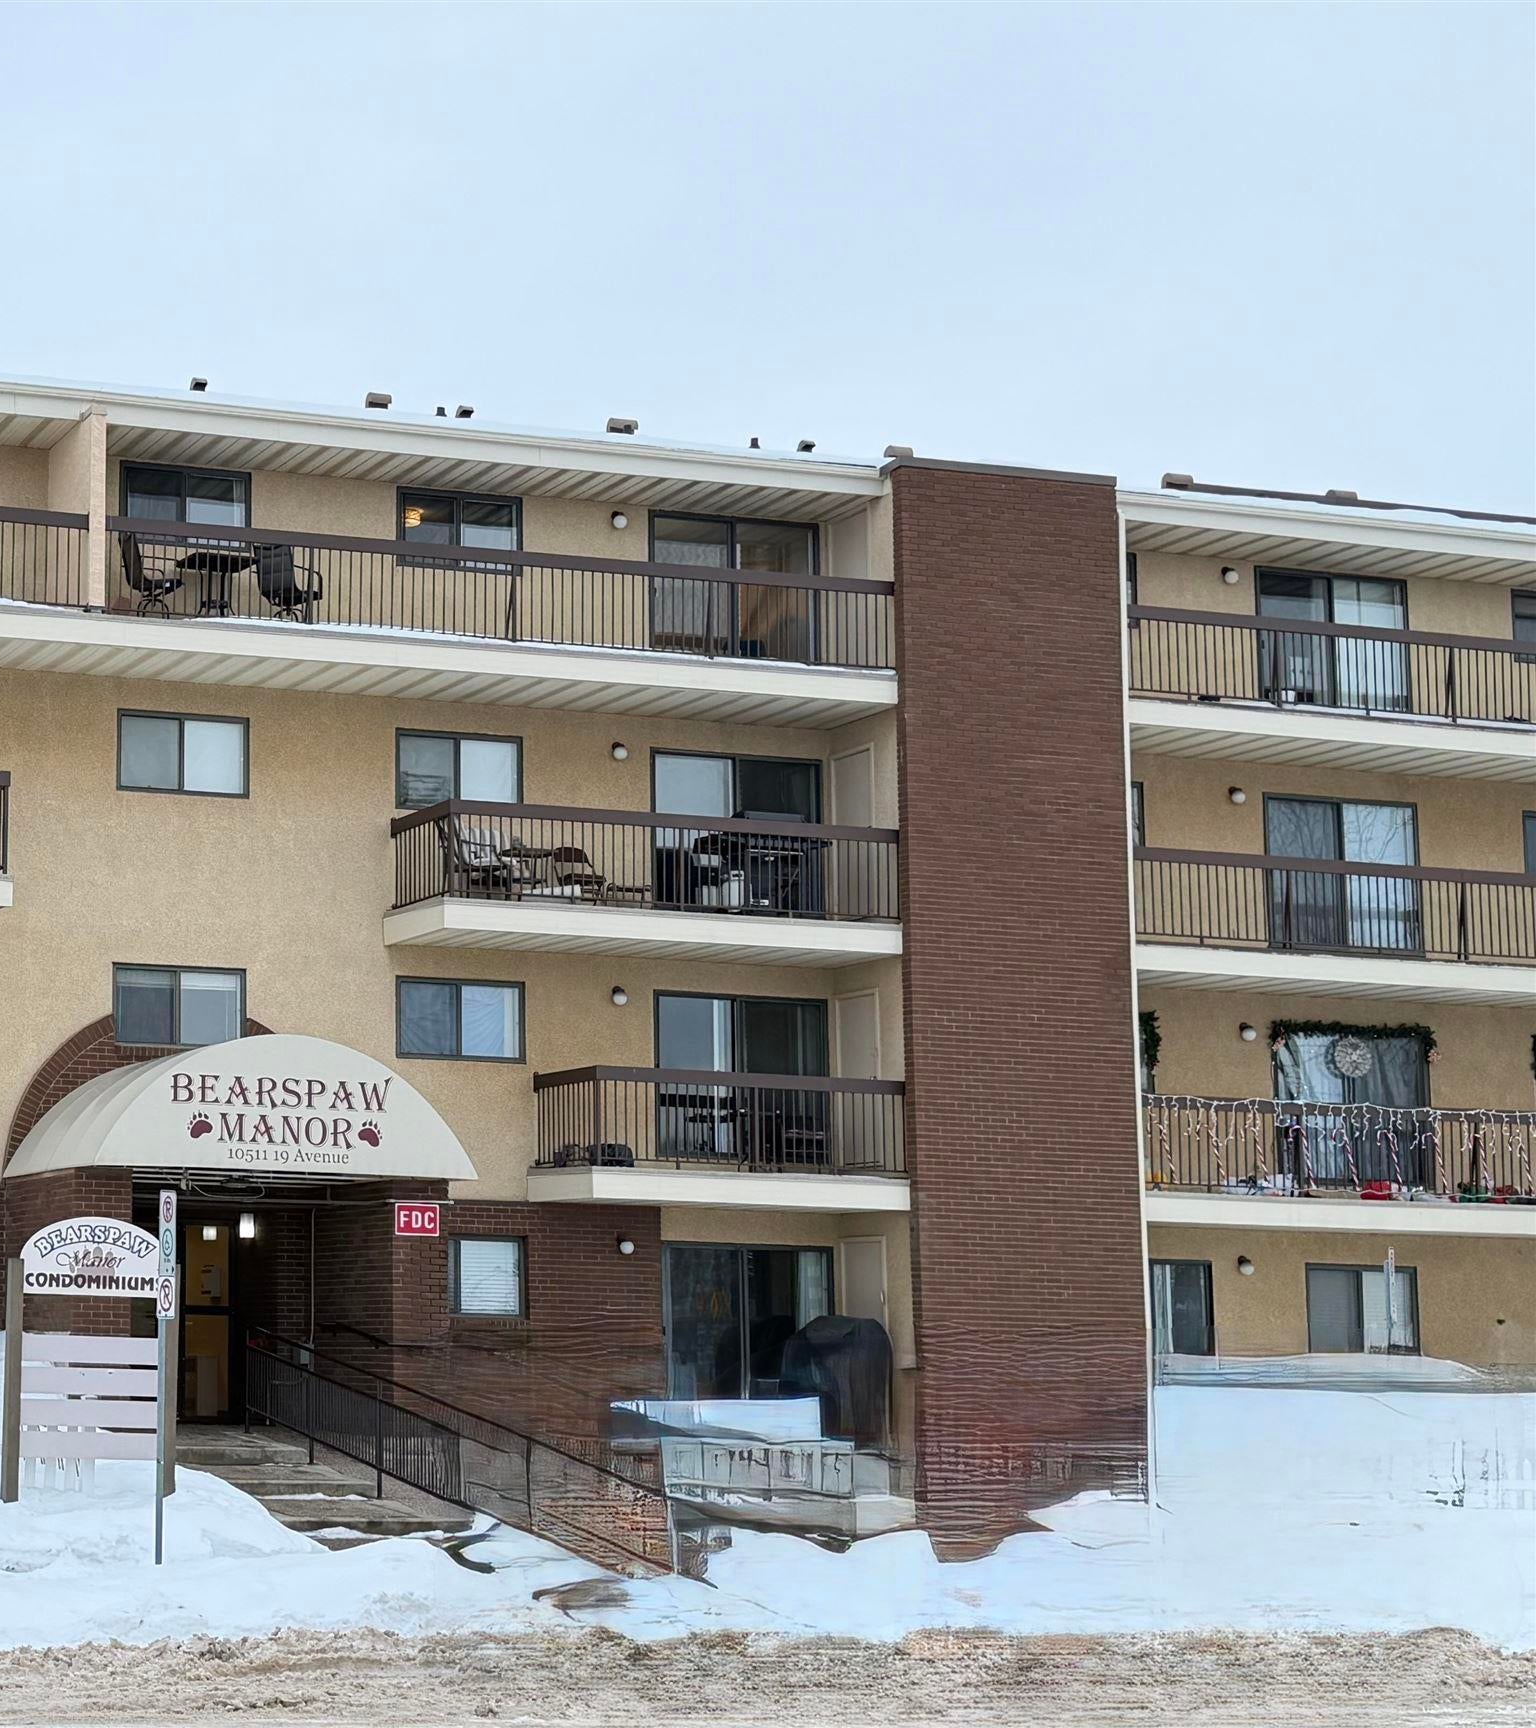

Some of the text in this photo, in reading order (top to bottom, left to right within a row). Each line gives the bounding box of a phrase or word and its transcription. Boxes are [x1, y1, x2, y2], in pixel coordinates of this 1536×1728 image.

[170, 1073, 393, 1113] BEARSPAW
[216, 1112, 356, 1150] MANOR
[227, 1148, 349, 1164] 10511 19 Avenue
[399, 1210, 435, 1229] FDC
[34, 1225, 157, 1258] BEARSPAW
[56, 1250, 125, 1268] Manor
